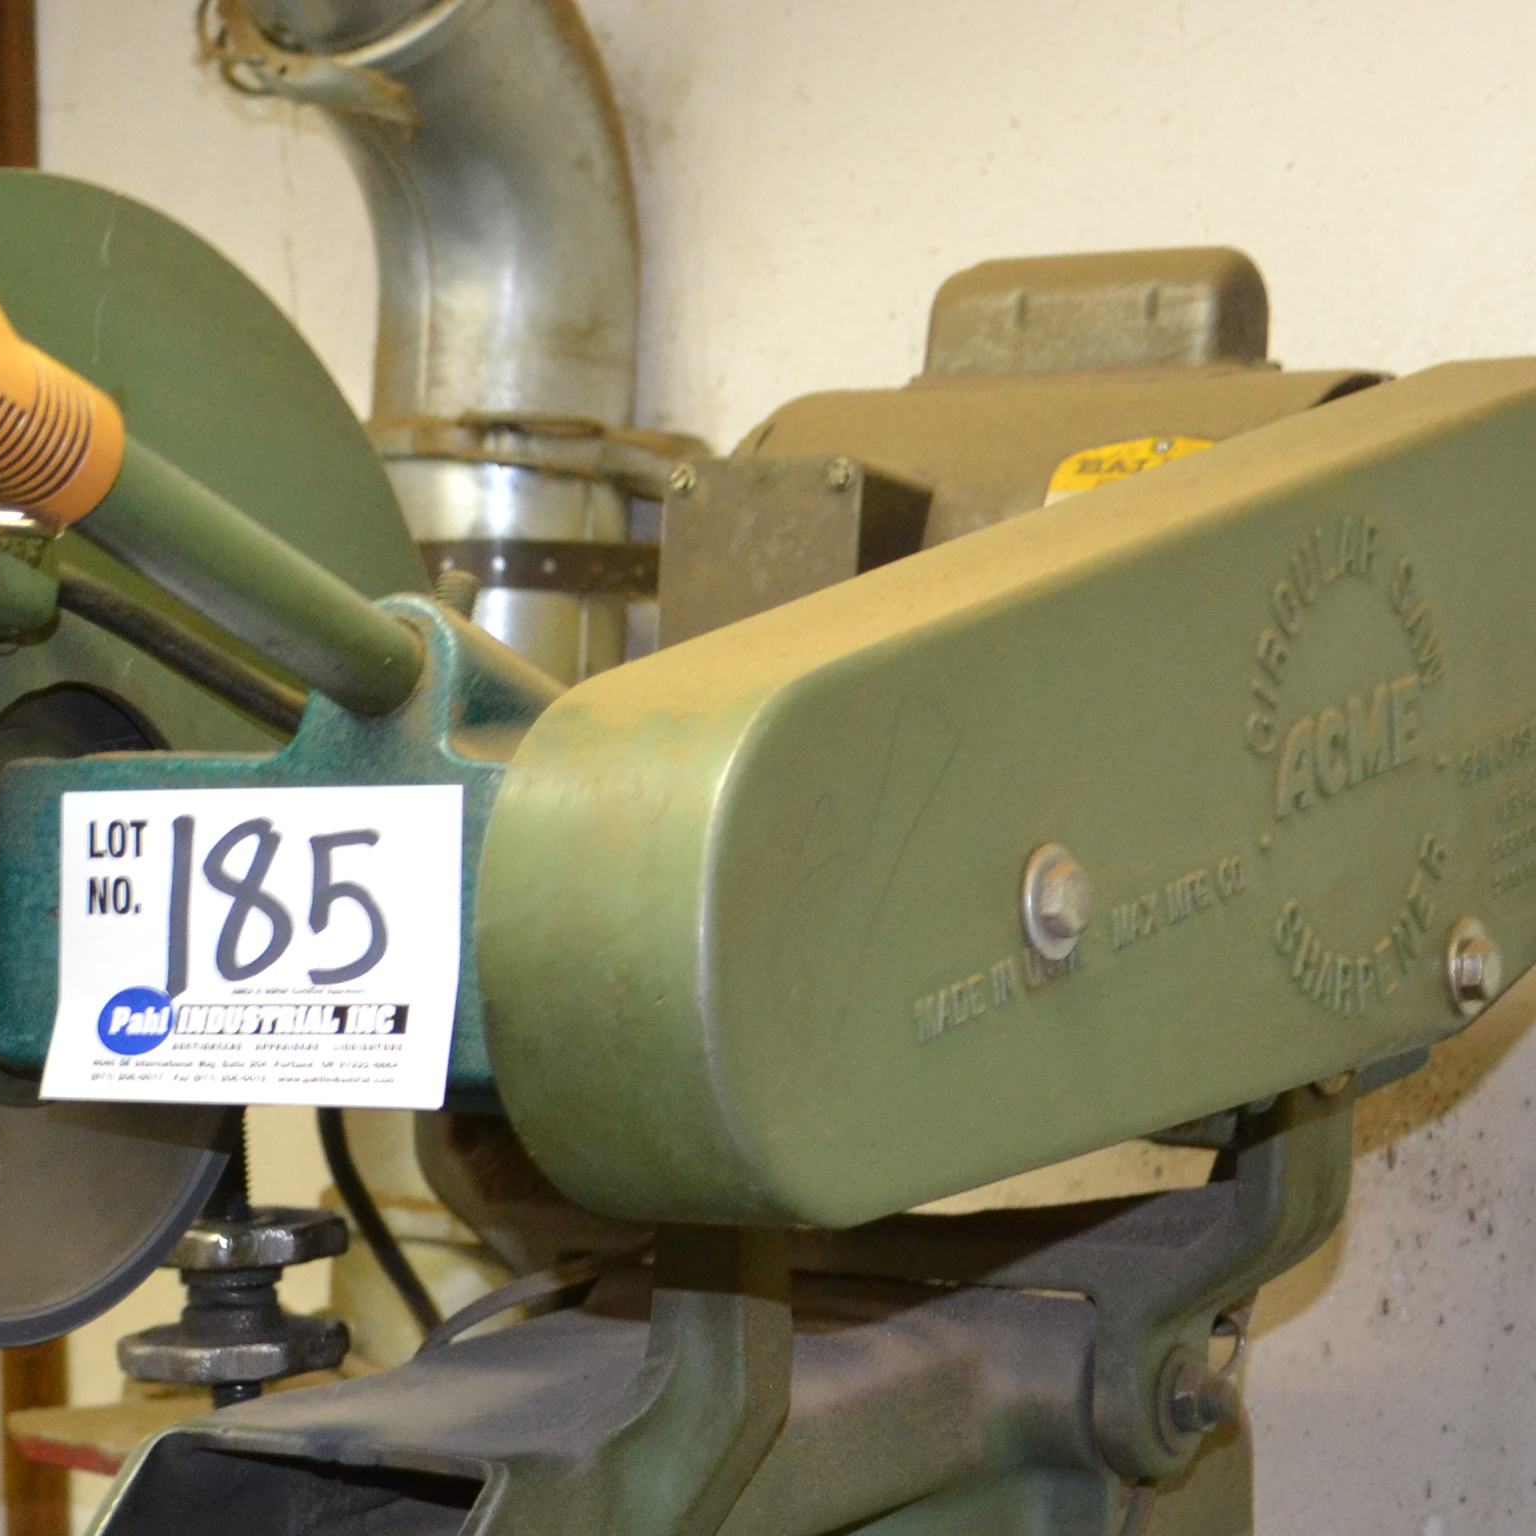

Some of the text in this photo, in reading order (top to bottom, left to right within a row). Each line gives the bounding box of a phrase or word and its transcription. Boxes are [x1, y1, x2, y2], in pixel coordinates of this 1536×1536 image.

[1275, 674, 1422, 822] ACME
[88, 819, 148, 858] LOT
[88, 876, 142, 915] NO.
[165, 814, 388, 1000] 185
[1275, 831, 1449, 1019] SHARPENER
[108, 1005, 397, 1036] Pahl INDUSTRIAL INC
